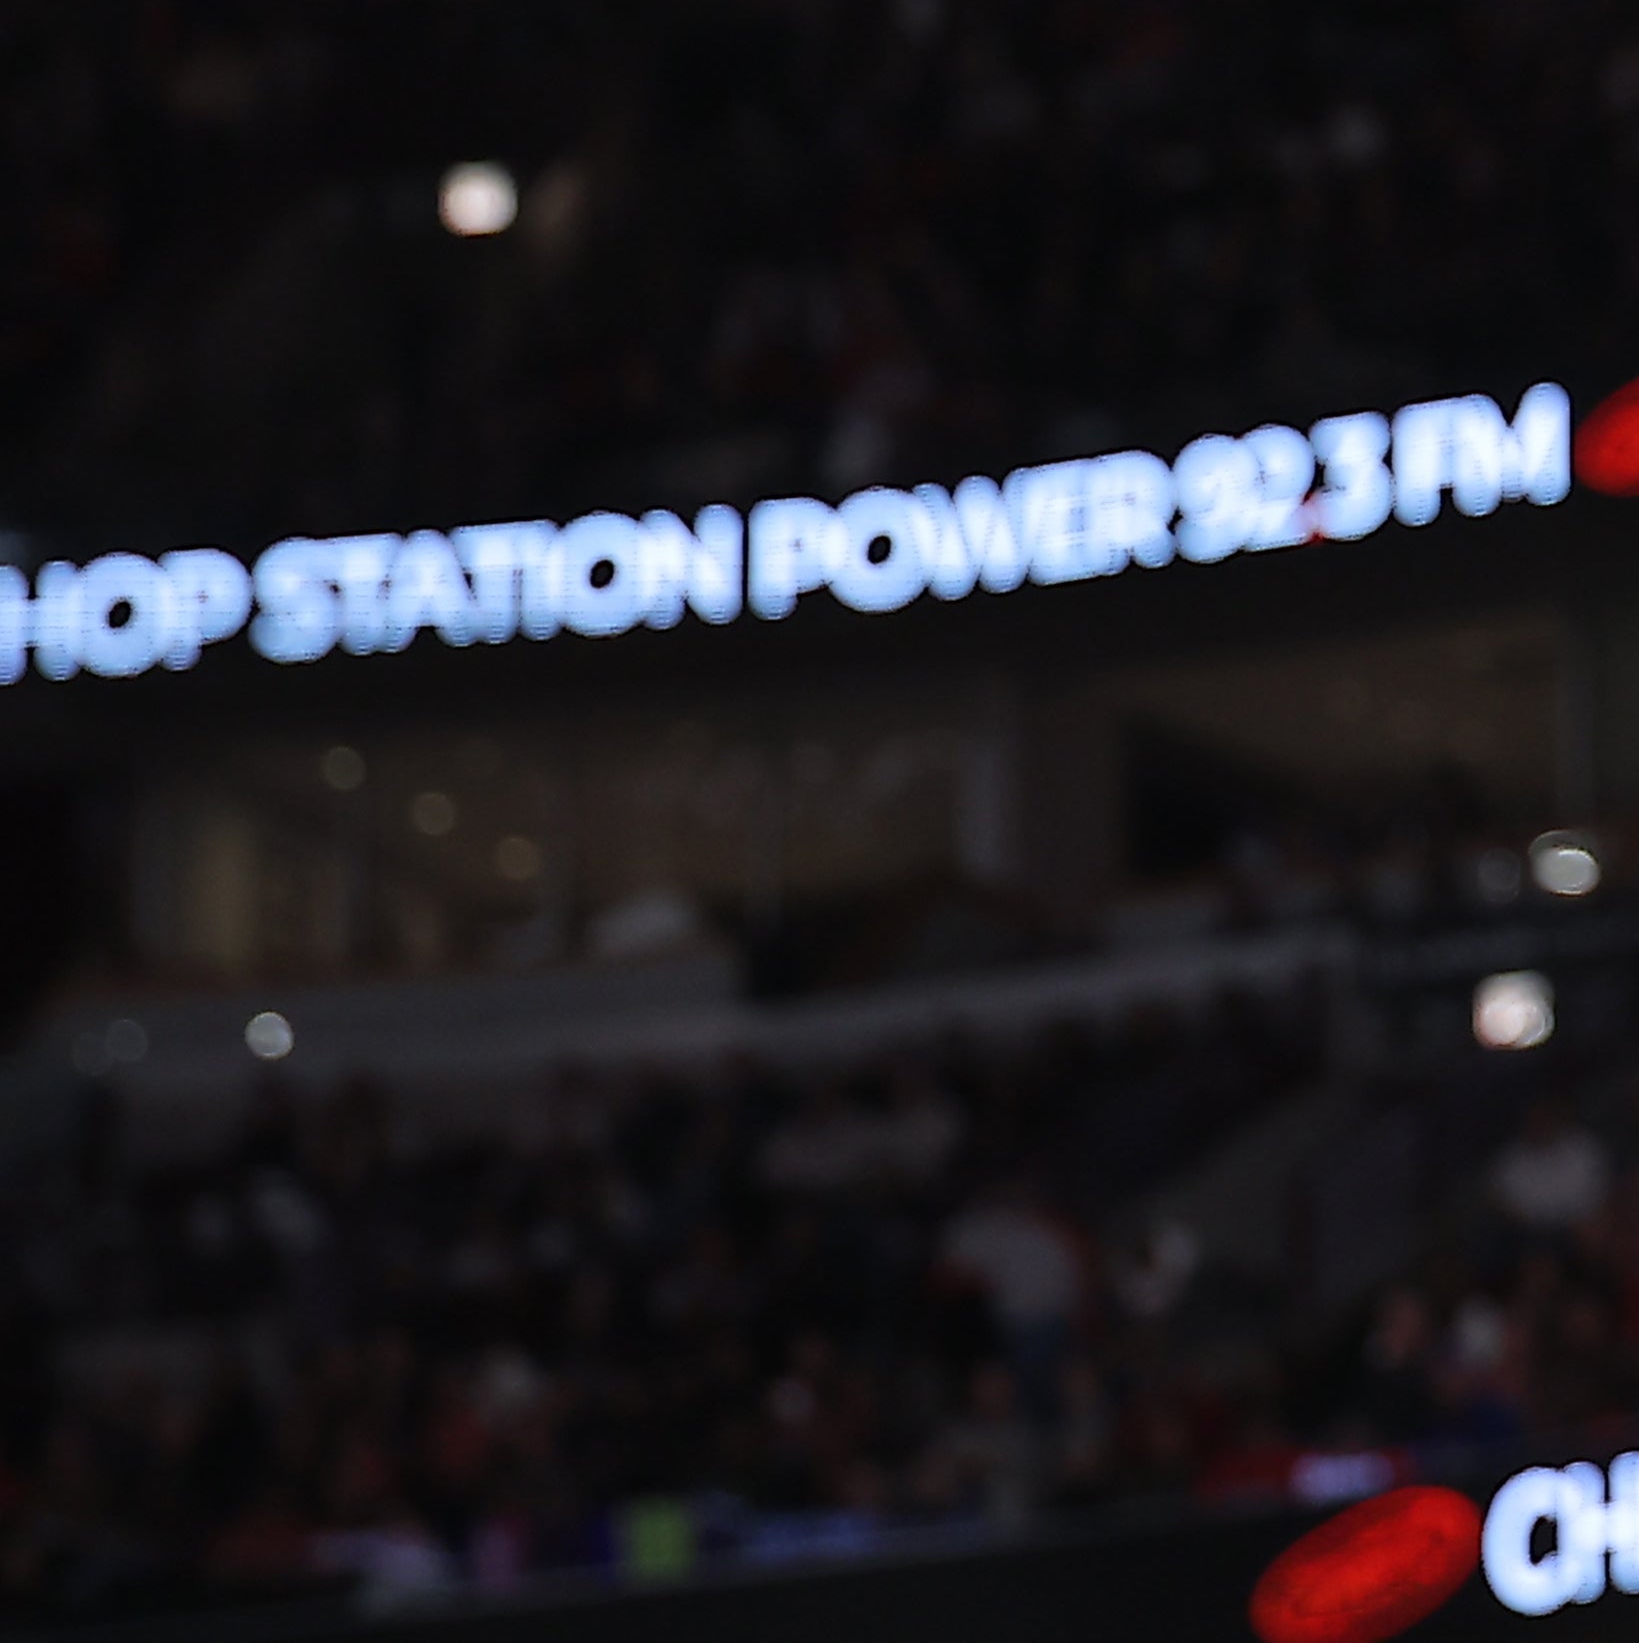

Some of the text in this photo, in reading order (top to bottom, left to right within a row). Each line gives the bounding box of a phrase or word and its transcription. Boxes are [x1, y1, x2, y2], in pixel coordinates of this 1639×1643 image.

[0, 547, 253, 686] HOP
[248, 502, 745, 664] STATION
[746, 448, 1174, 622] POWER
[1391, 381, 1571, 527] FM
